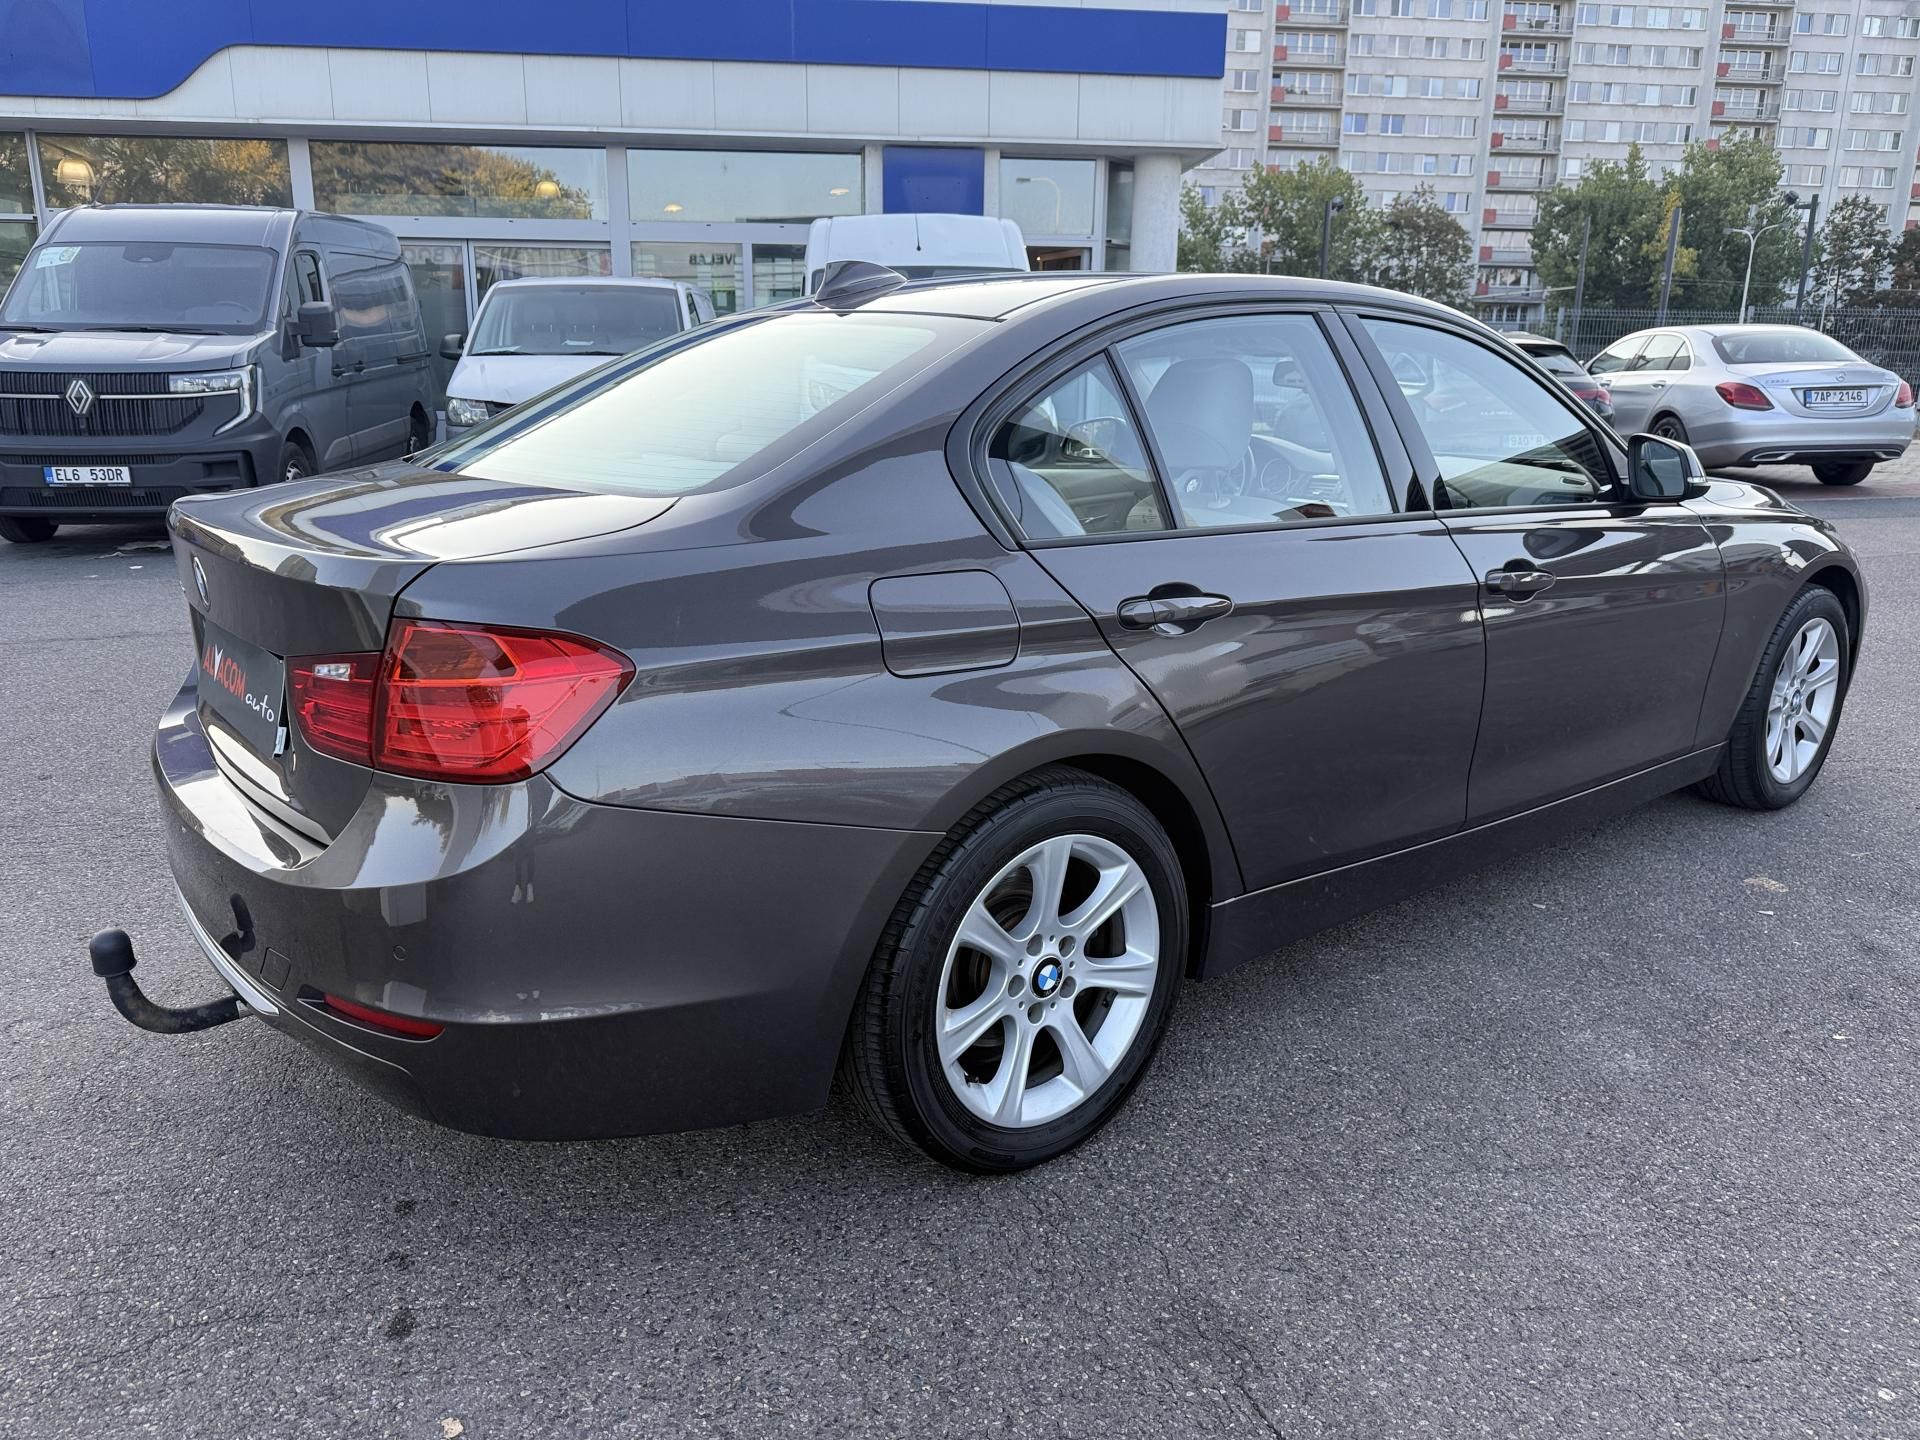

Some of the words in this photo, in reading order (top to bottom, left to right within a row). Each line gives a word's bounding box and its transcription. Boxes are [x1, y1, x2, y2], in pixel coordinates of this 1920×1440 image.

[1813, 391, 1832, 402] 7AP
[1838, 391, 1863, 402] 2146
[55, 468, 81, 481] EL6
[89, 468, 124, 481] 53DR
[245, 693, 275, 722] auto
